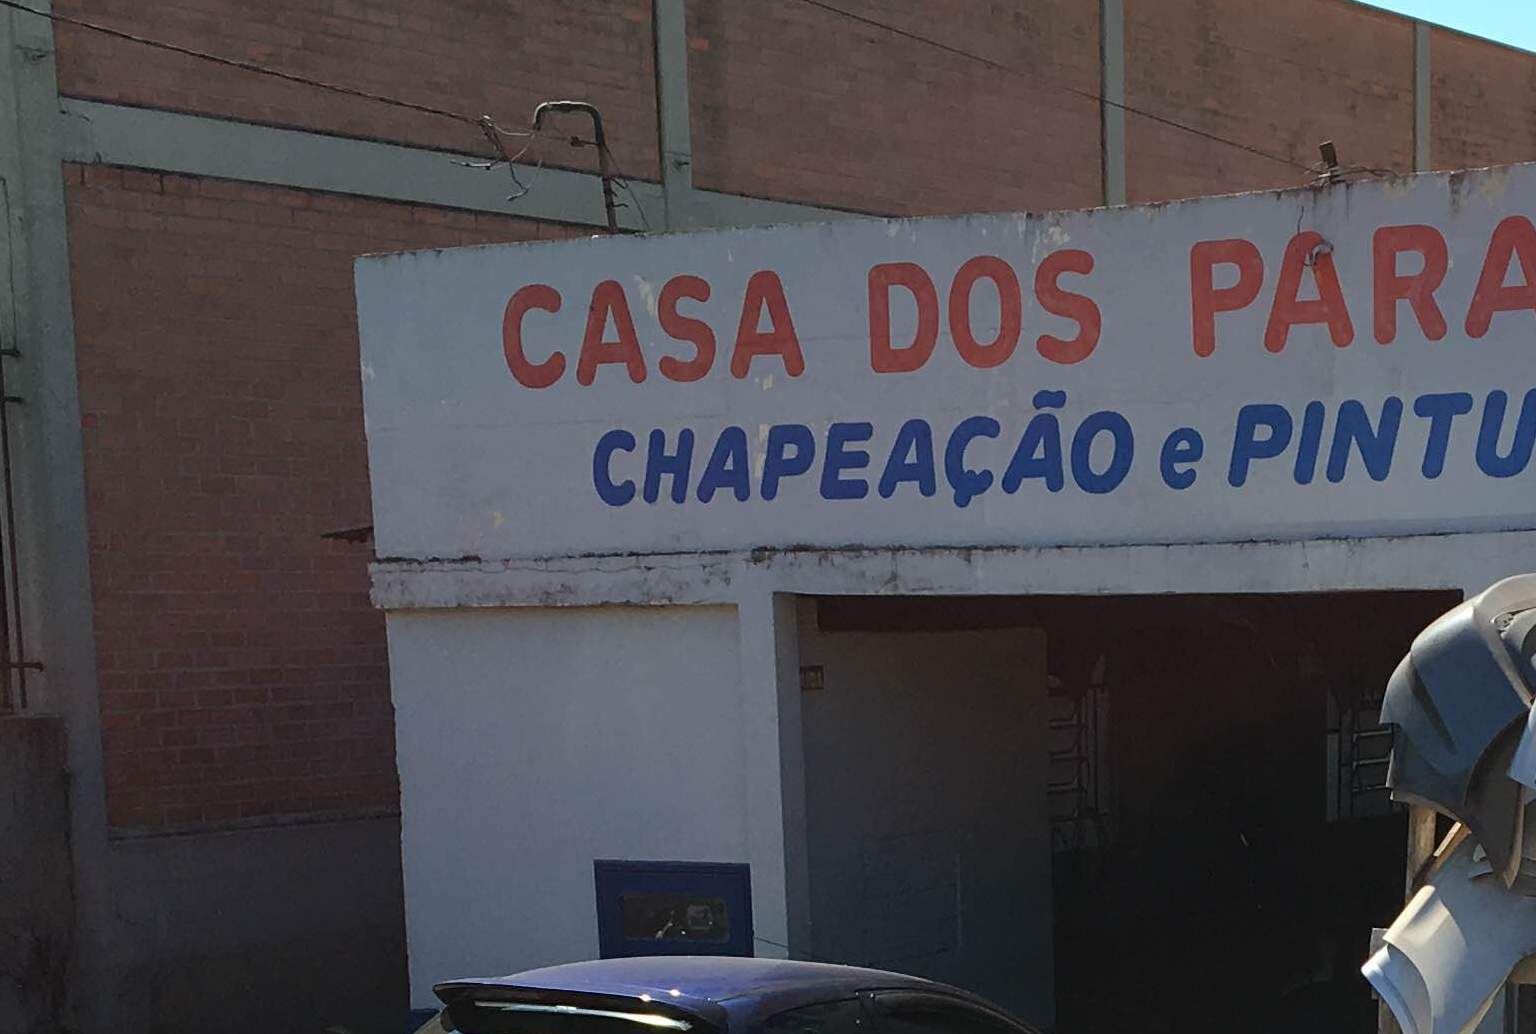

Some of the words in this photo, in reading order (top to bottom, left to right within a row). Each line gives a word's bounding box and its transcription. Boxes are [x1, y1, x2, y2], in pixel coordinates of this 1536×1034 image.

[503, 270, 806, 388] CASA
[868, 249, 1102, 373] DOS
[593, 390, 1134, 508] CHAPEAÇÃO
[1159, 427, 1205, 490] e
